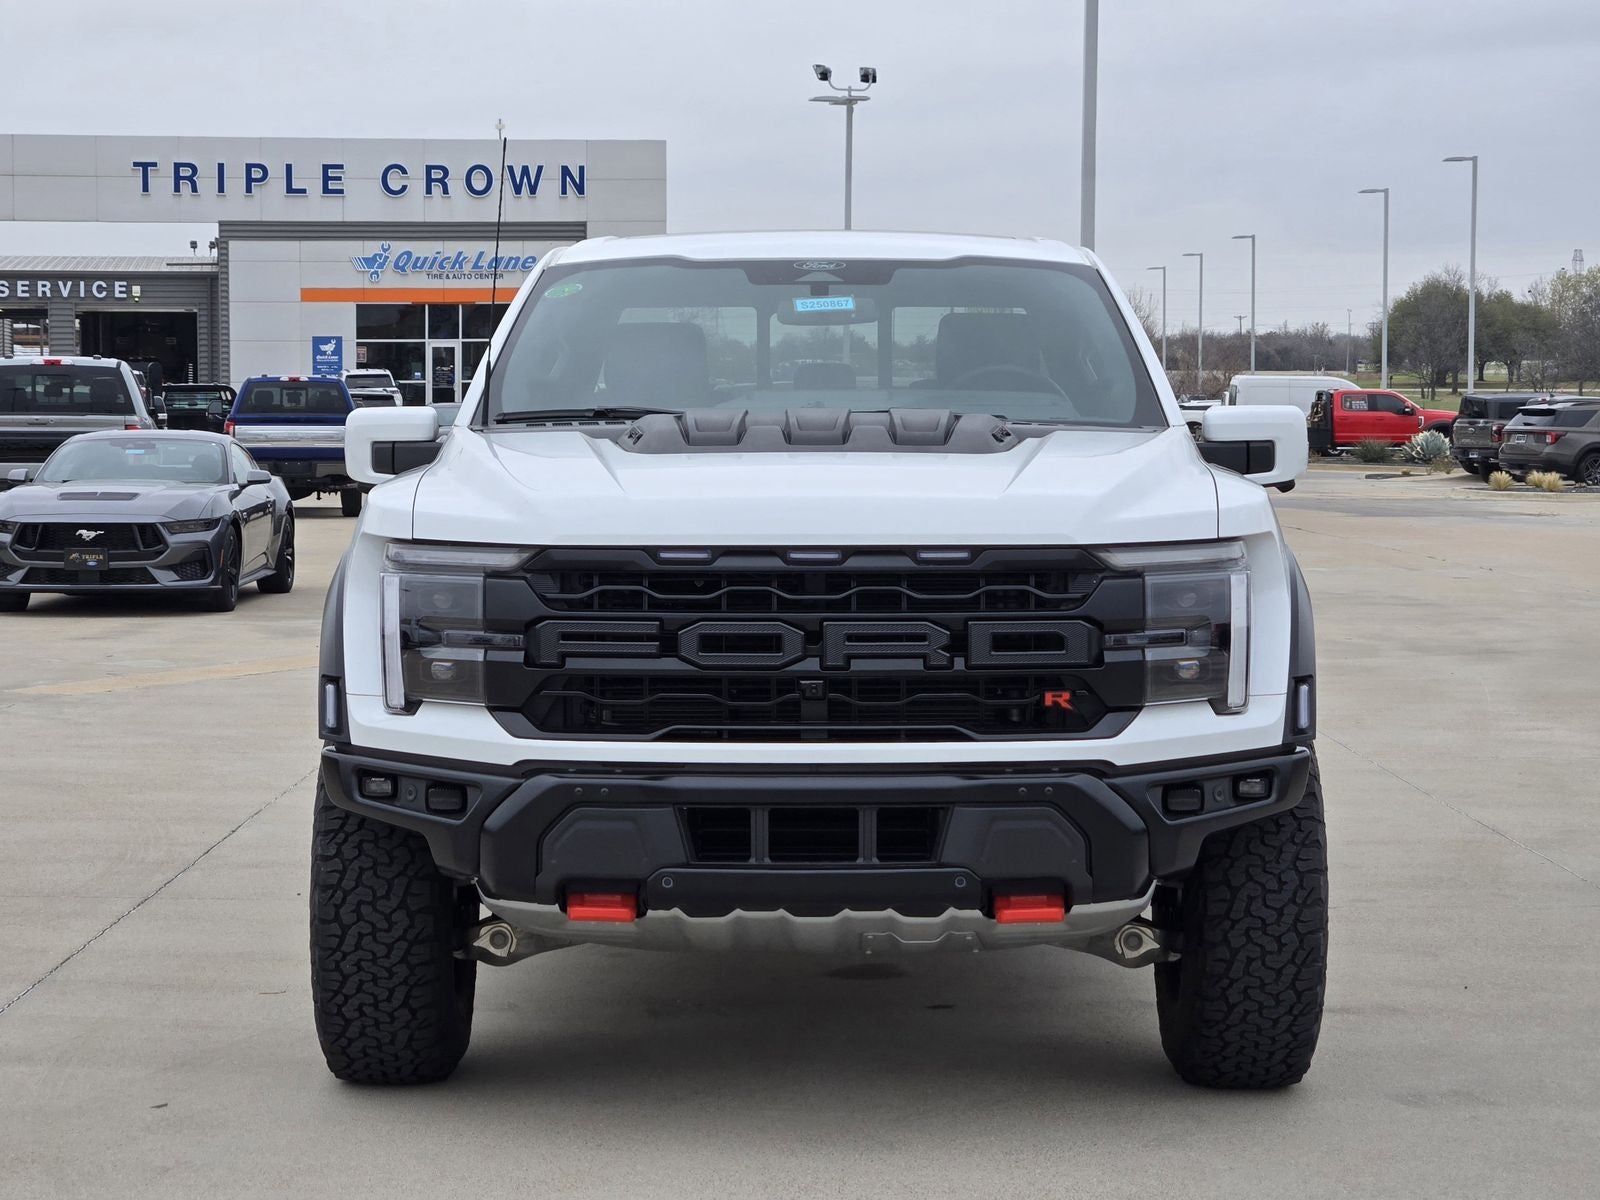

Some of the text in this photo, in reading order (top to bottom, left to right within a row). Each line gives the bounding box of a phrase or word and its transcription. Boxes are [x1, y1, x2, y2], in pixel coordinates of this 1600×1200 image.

[132, 161, 586, 197] TRIPLE CROWN
[393, 250, 537, 273] Quick Lane
[0, 280, 128, 298] SERVICE
[800, 300, 850, 310] S250867
[528, 619, 1101, 669] FORD
[1044, 690, 1073, 711] R
